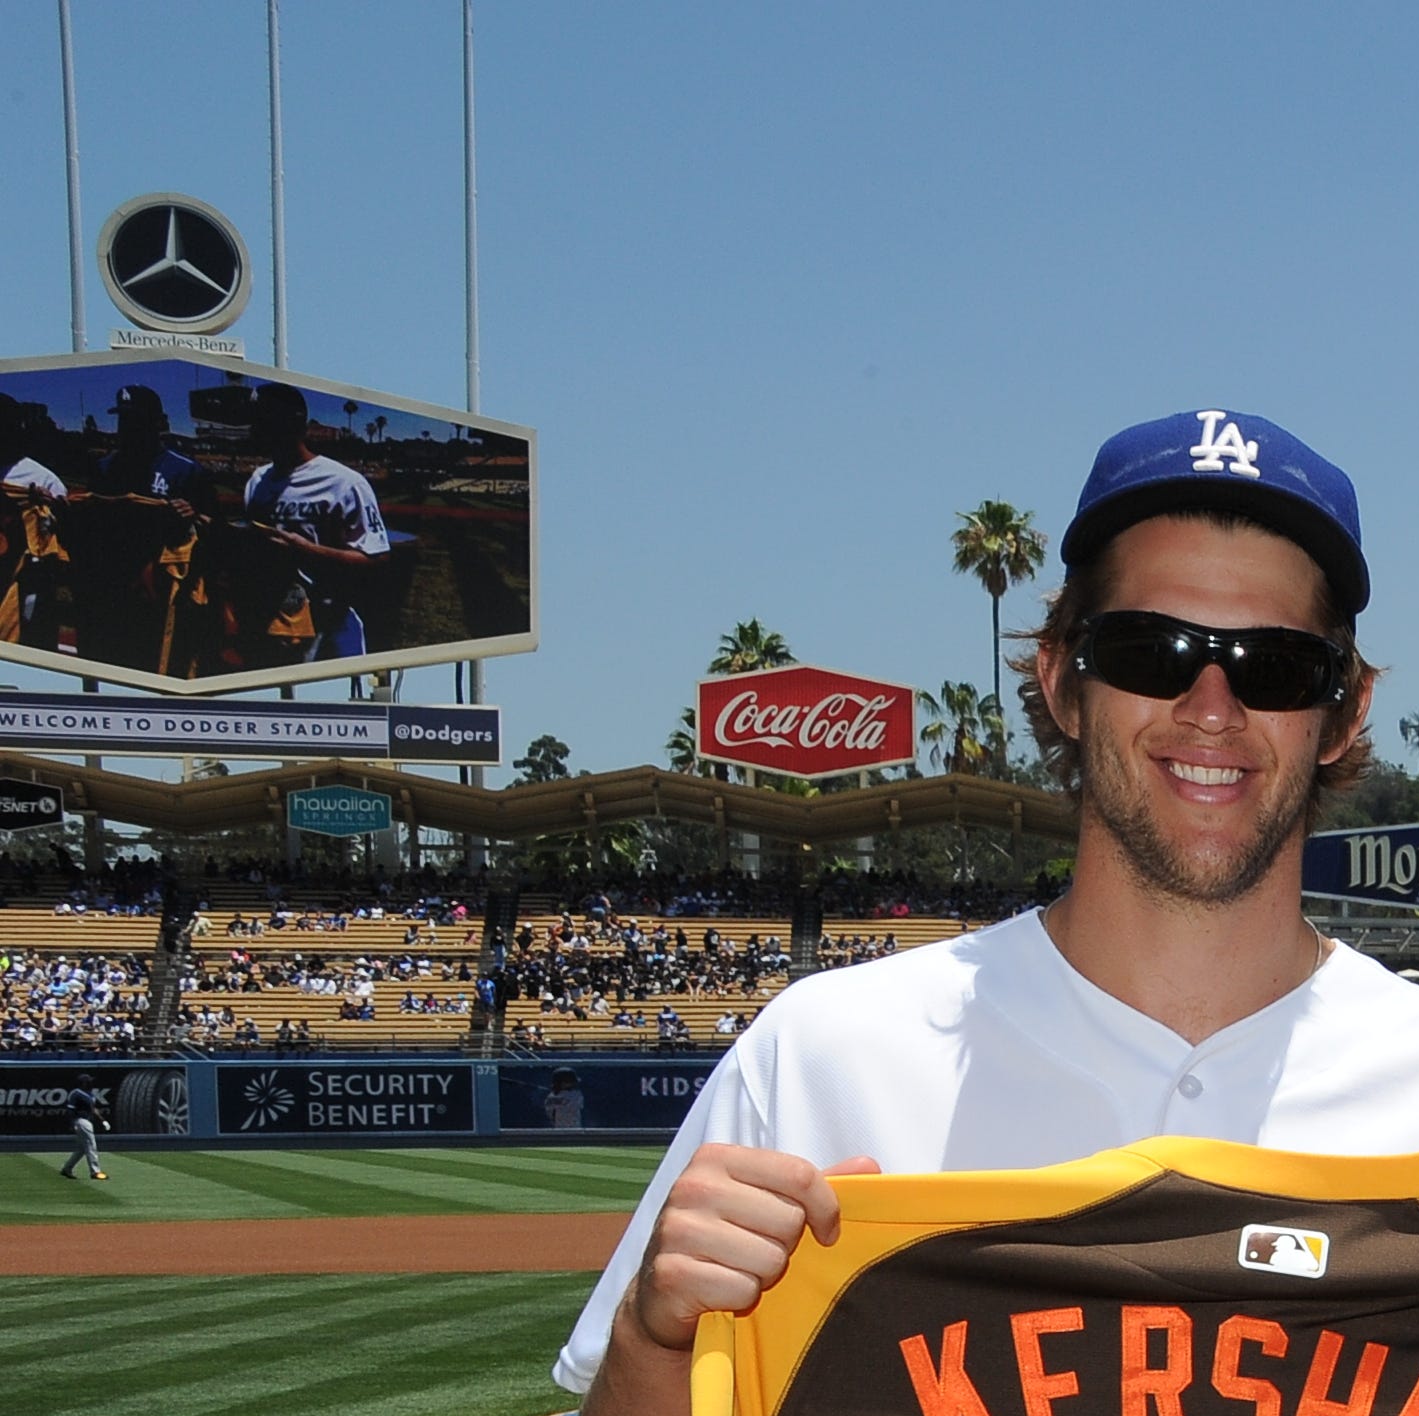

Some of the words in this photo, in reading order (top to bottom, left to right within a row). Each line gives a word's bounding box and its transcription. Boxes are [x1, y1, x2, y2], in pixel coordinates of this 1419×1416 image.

[118, 331, 237, 352] Mercedes-Benz
[1190, 410, 1260, 479] LA
[0, 714, 112, 730] WELCOME
[124, 718, 151, 731] TO
[165, 720, 257, 734] DODGER
[271, 723, 369, 738] STADIUM
[715, 691, 896, 750] Coca-Cola
[394, 724, 493, 746] @Dodgers
[0, 801, 38, 813] SNET
[294, 794, 385, 811] hawaiian
[476, 1065, 498, 1076] 375
[309, 1071, 453, 1097] SECURITY
